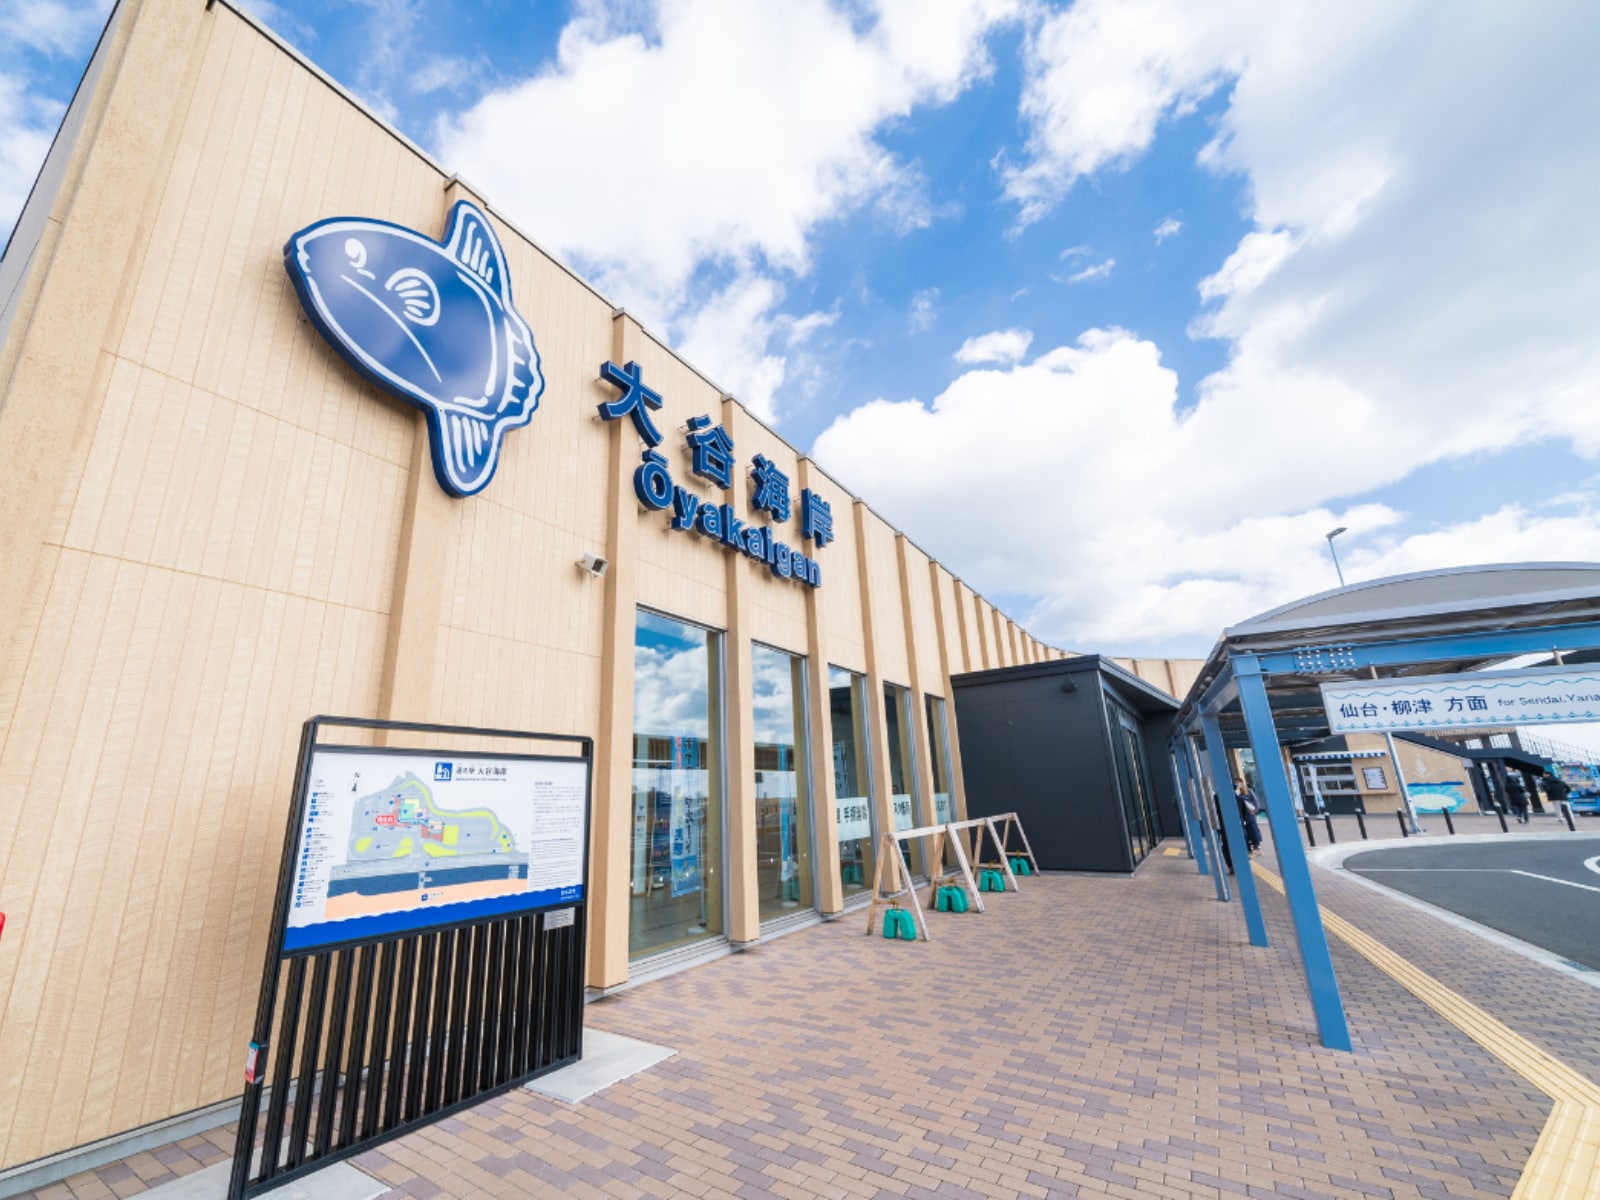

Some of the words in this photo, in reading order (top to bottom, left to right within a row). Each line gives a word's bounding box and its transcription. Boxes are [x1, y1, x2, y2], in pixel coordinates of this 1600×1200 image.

[597, 360, 834, 547] 大谷海岸
[633, 448, 822, 588] Ōyakaigan
[1339, 698, 1434, 719] 仙台・柳津
[1444, 695, 1489, 713] 方面
[1498, 698, 1515, 706] for
